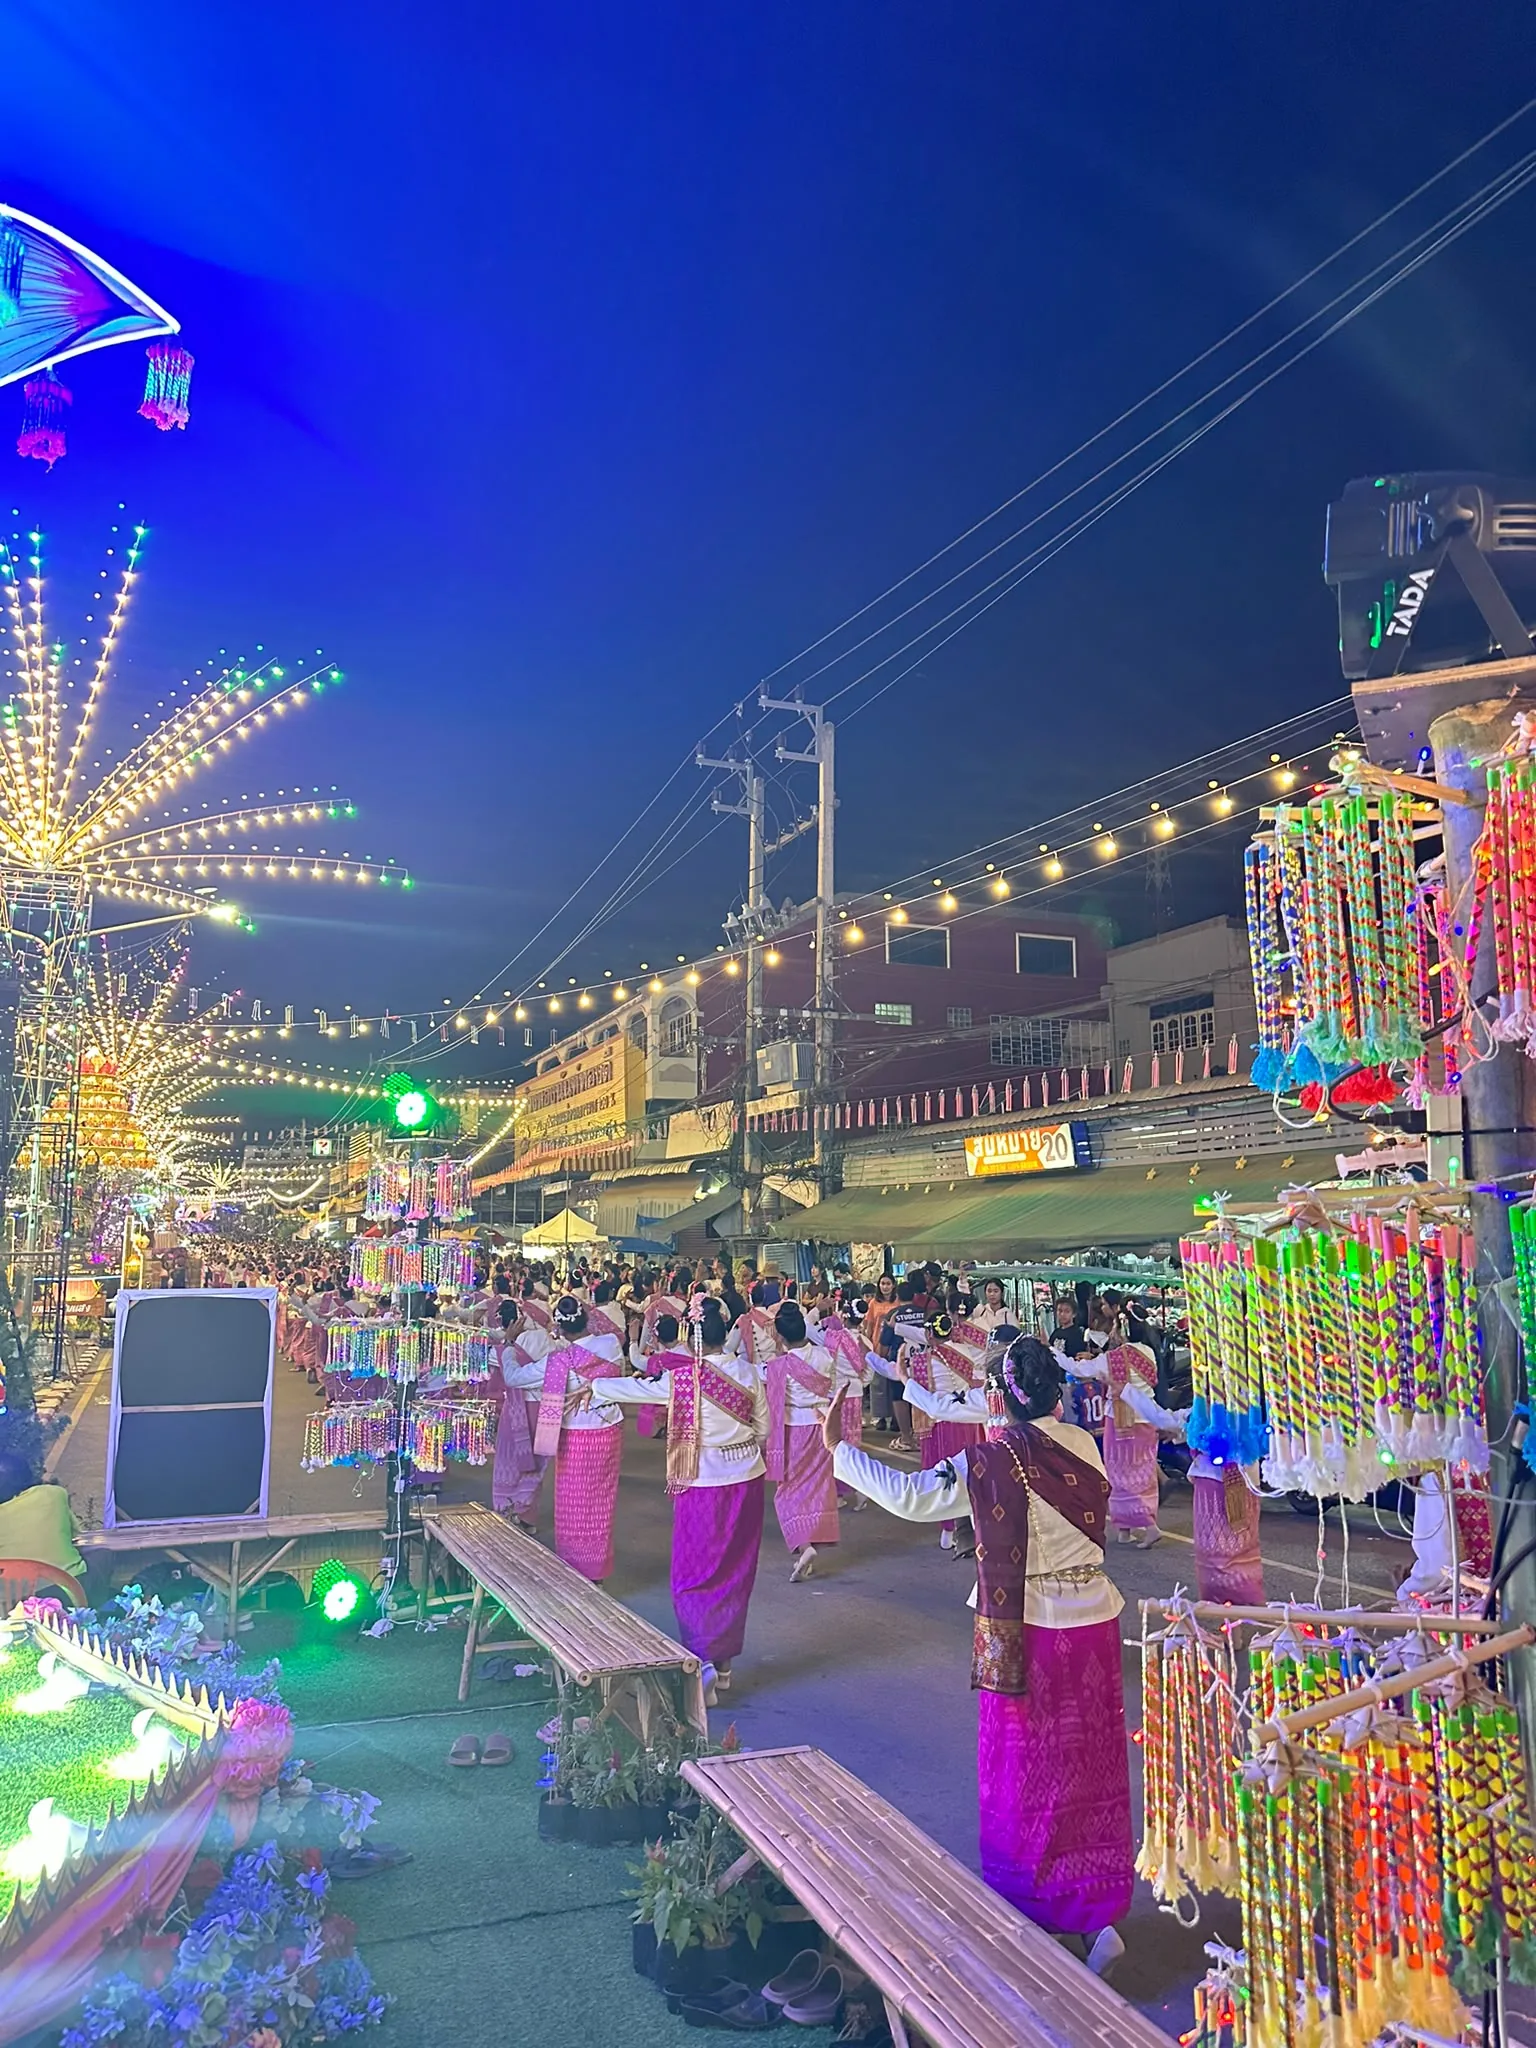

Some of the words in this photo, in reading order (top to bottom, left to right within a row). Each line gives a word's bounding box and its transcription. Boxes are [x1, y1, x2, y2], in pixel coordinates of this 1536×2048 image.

[1386, 568, 1435, 637] TADA
[1041, 1132, 1068, 1162] 20
[895, 1312, 925, 1323] STUDENT
[1083, 1394, 1104, 1423] 10
